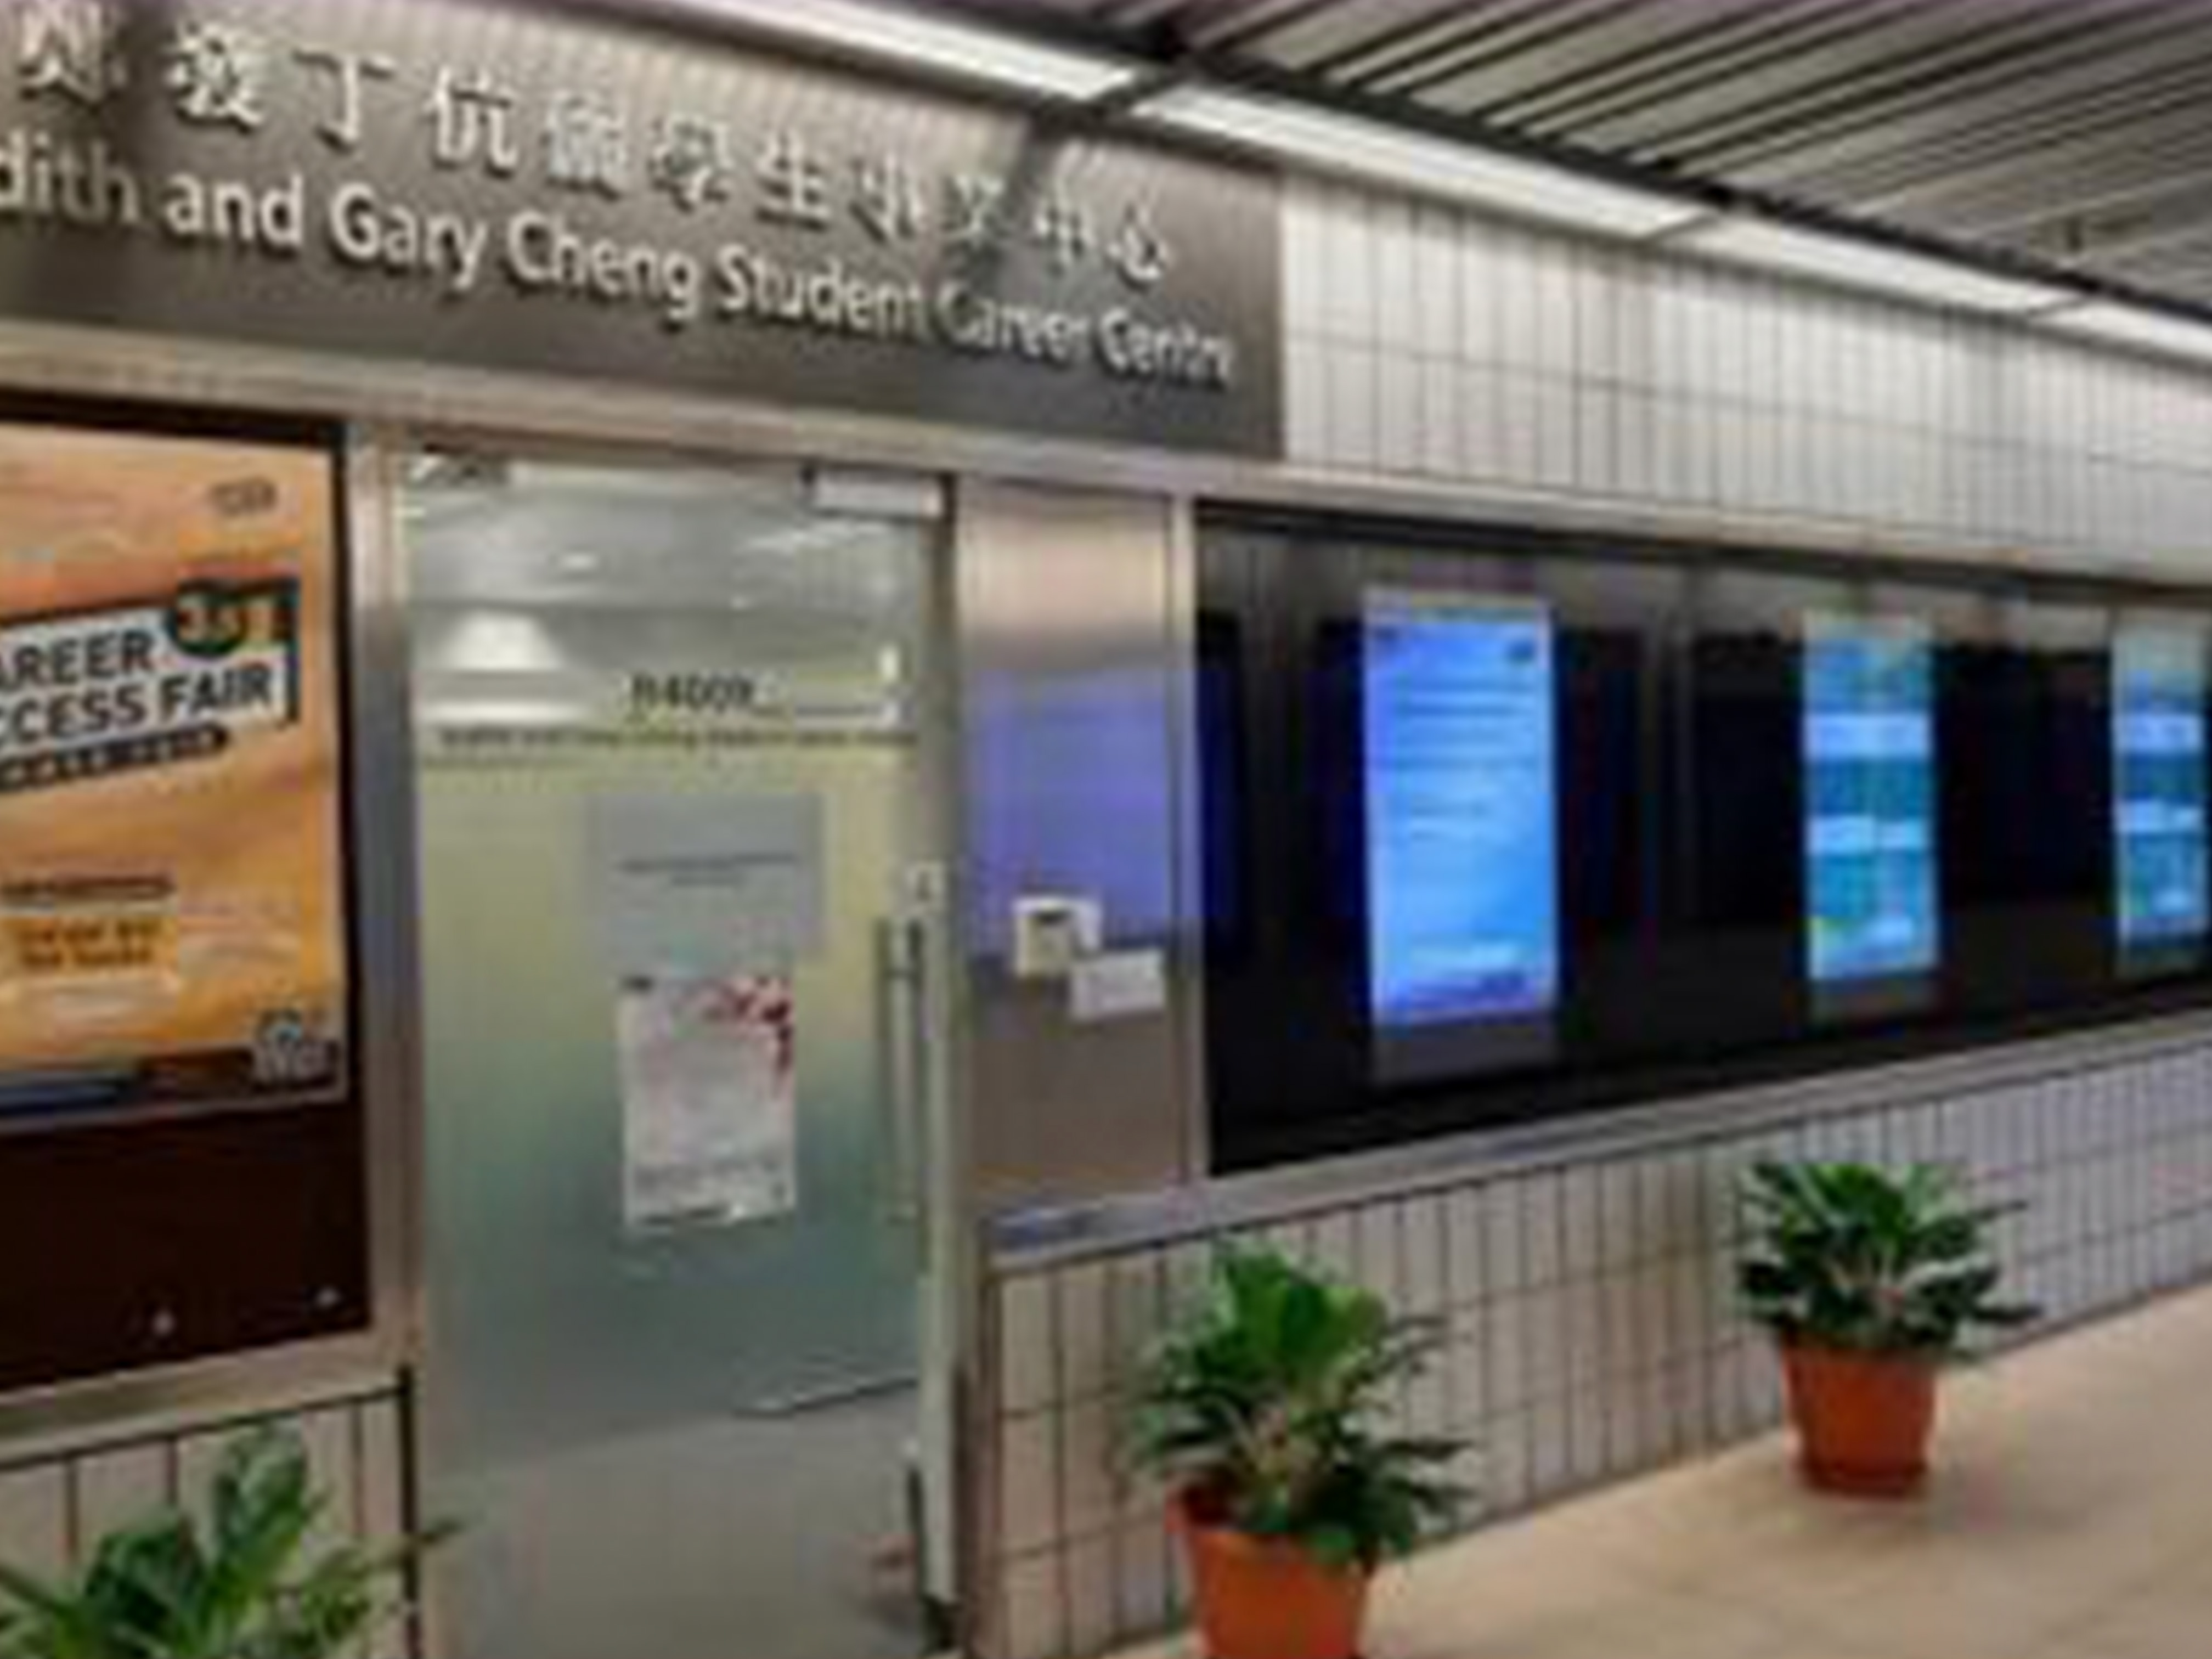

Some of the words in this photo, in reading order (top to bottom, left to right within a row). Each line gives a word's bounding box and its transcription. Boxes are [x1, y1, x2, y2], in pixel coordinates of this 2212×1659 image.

[166, 172, 303, 247] and
[330, 183, 487, 288] Gary
[506, 210, 699, 319] Cheng
[718, 244, 924, 336] Student
[0, 686, 148, 744] CESS
[159, 663, 272, 720] FAIR
